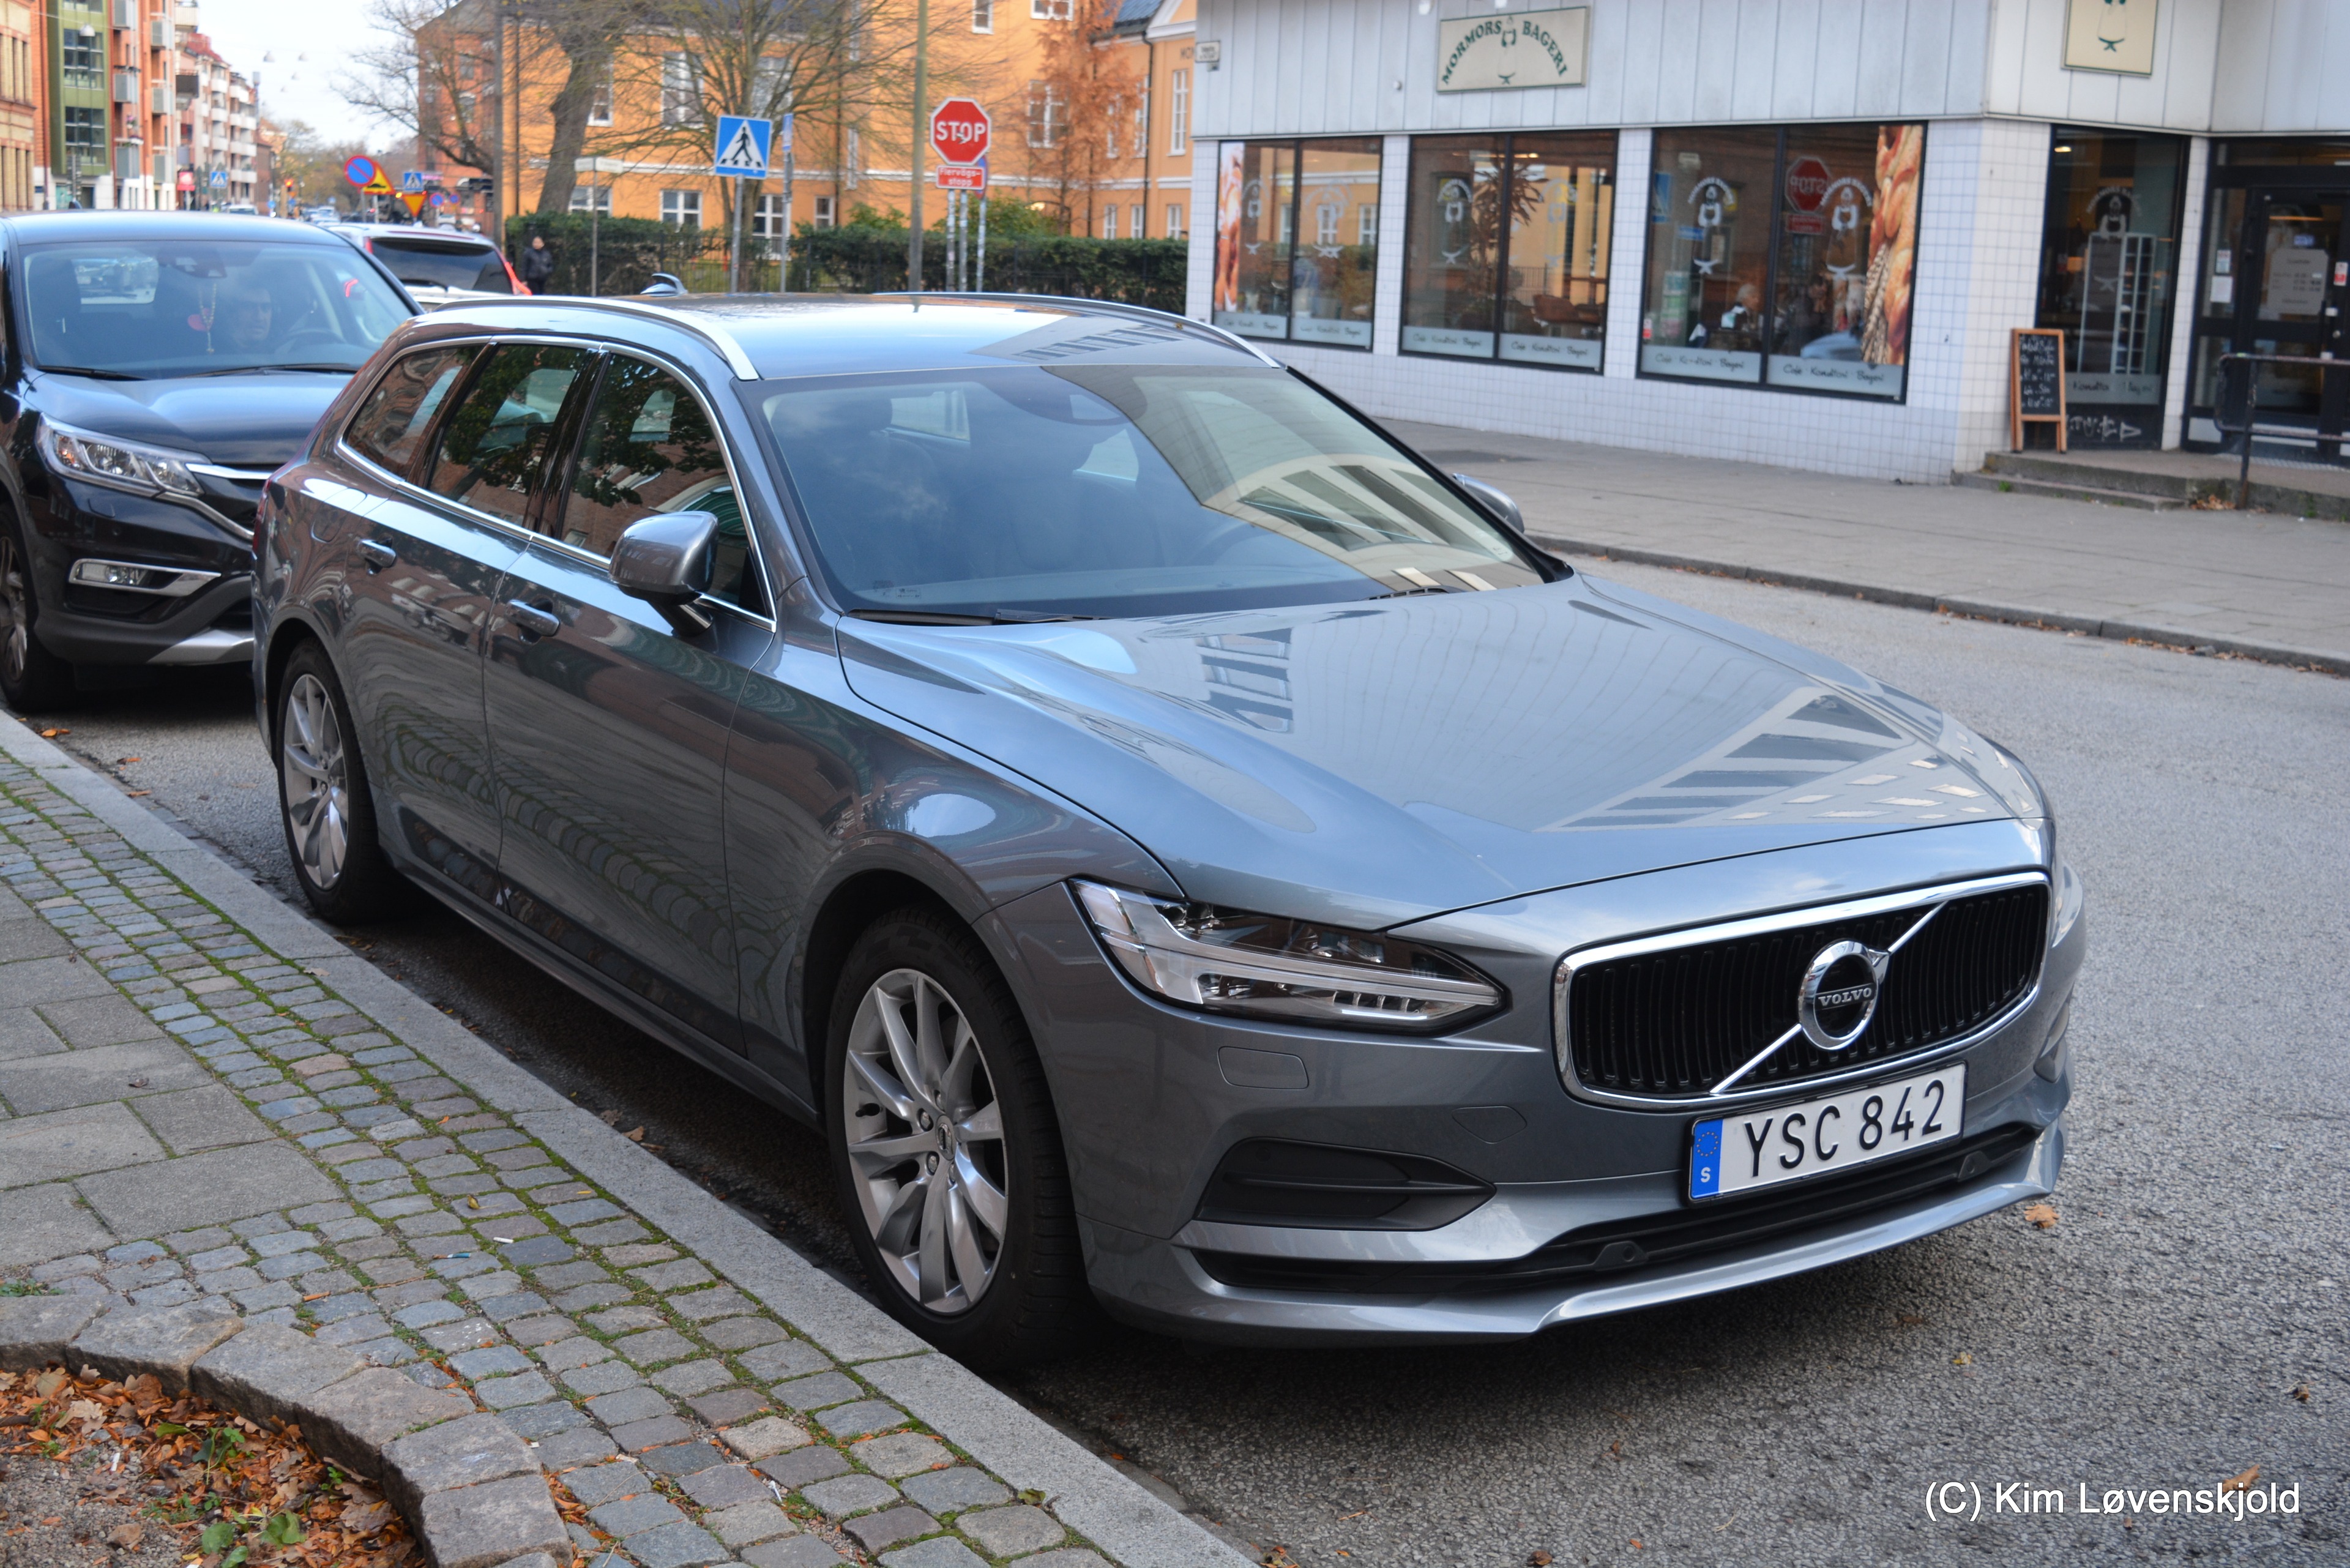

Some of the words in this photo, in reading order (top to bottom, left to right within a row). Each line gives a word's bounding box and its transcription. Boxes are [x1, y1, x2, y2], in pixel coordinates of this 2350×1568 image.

[1441, 20, 1502, 85] MORMORS
[1521, 20, 1568, 77] BAGERI
[936, 121, 986, 143] STOP
[1818, 987, 1872, 1006] VOLVO
[1744, 1104, 1841, 1178] YSC
[1859, 1079, 1945, 1151] 842
[1699, 1167, 1711, 1183] S
